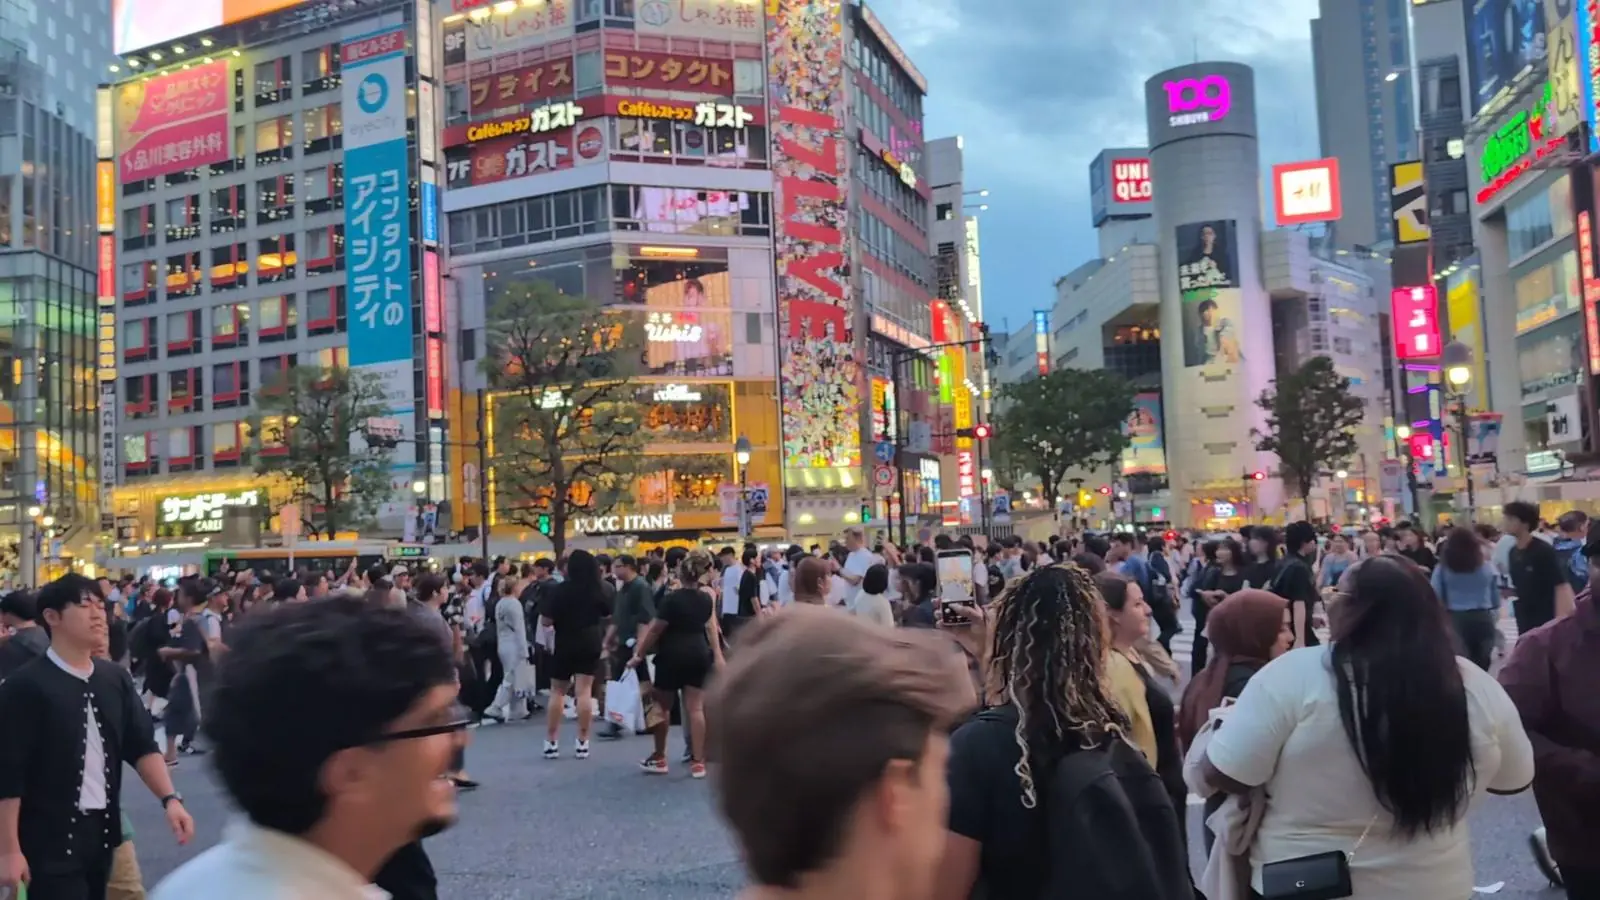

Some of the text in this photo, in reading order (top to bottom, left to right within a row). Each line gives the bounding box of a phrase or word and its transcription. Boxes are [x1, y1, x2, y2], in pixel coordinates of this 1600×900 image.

[606, 53, 730, 86] コンタクト
[1163, 74, 1231, 121] 109
[531, 100, 584, 133] ガスト
[694, 101, 754, 129] ガスト
[1169, 111, 1209, 127] SHIBUYA
[134, 131, 223, 171] 品川美容外科
[505, 140, 569, 177] ガスト
[447, 159, 472, 181] 7F
[1115, 163, 1149, 180] UNI
[1117, 180, 1152, 201] QLO
[351, 174, 381, 330] アイシティ
[381, 169, 404, 327] コンタクトの
